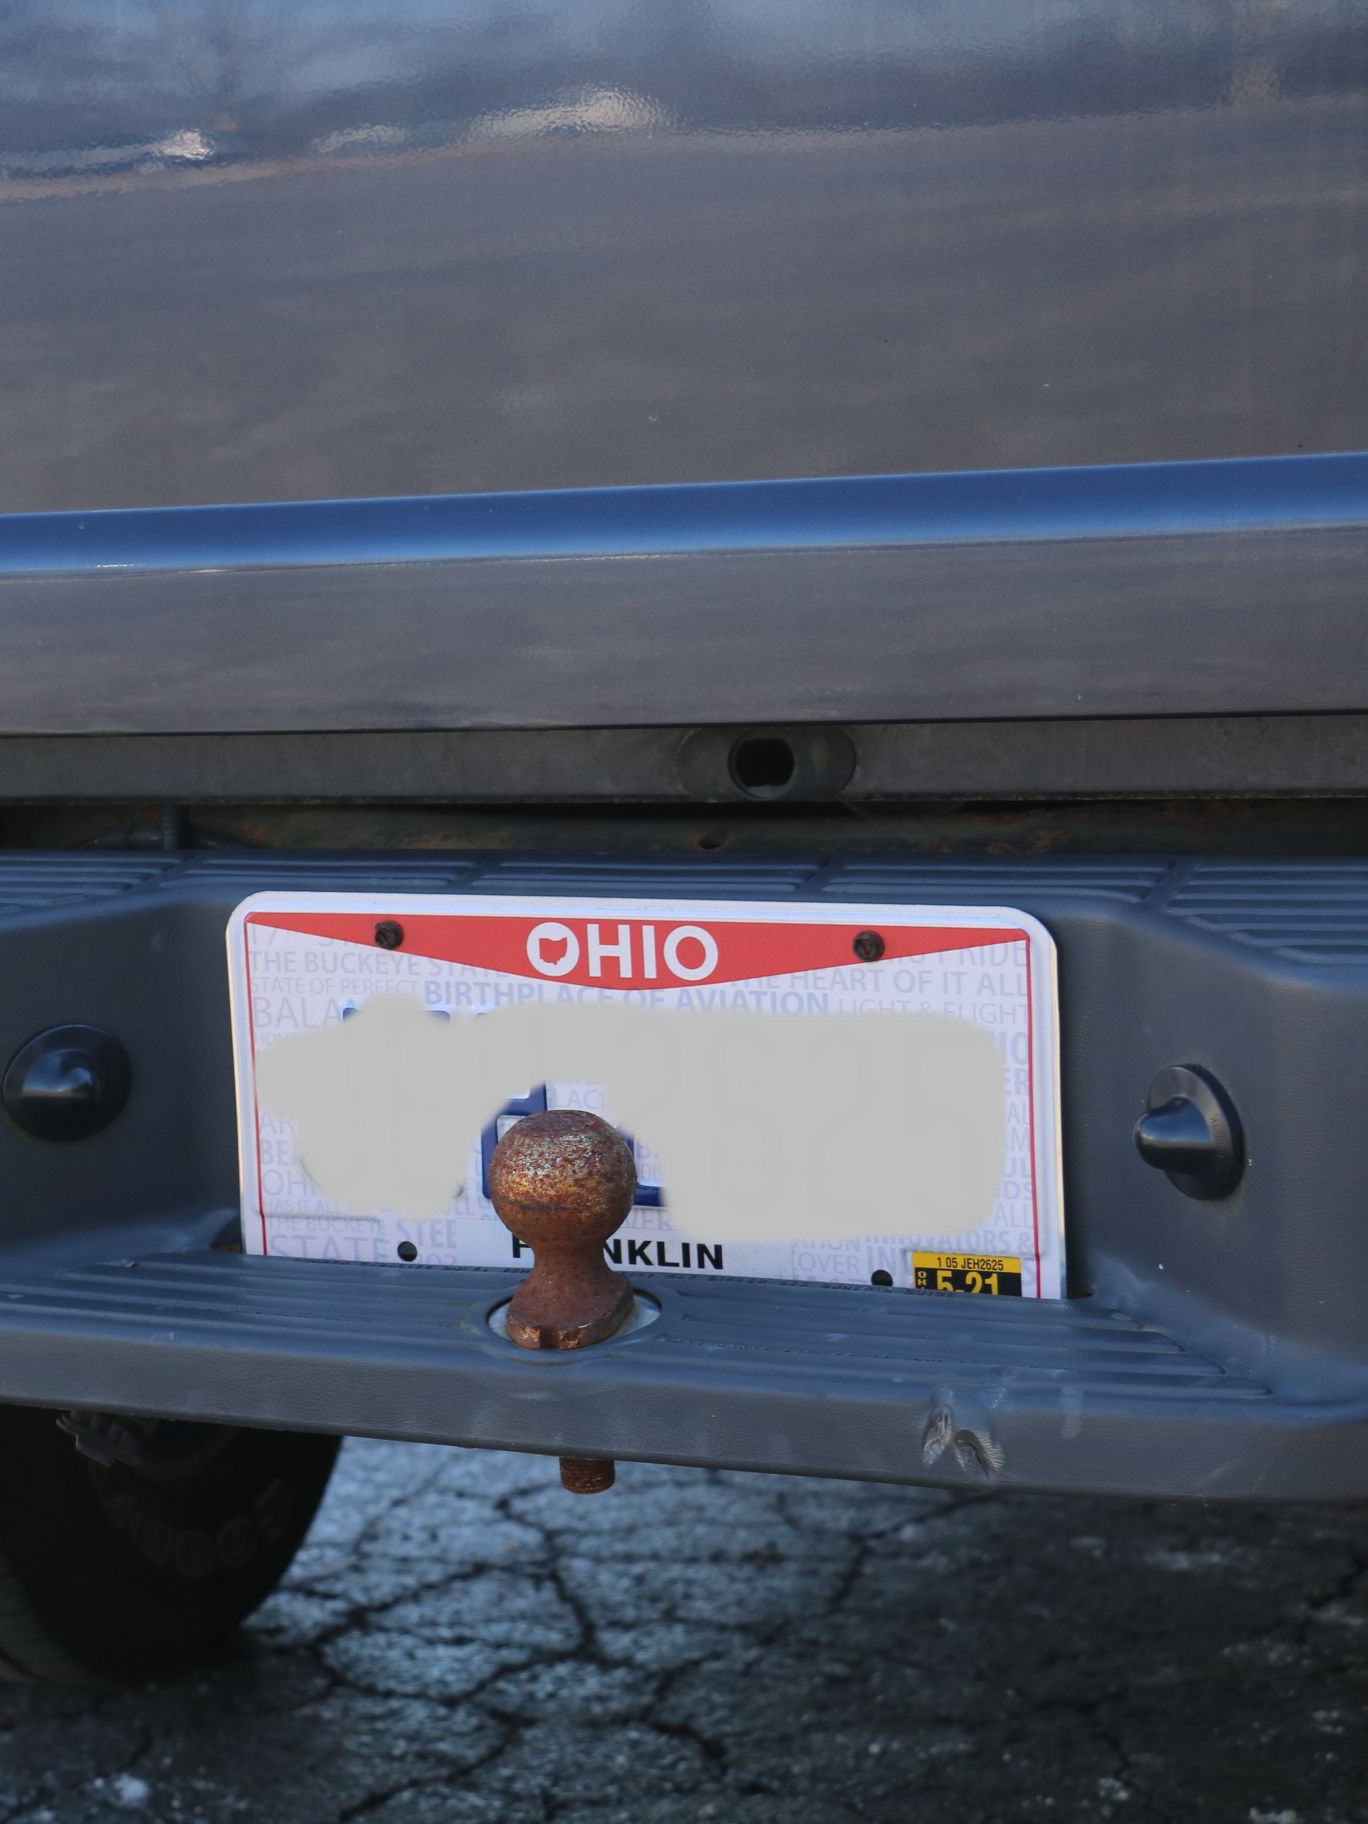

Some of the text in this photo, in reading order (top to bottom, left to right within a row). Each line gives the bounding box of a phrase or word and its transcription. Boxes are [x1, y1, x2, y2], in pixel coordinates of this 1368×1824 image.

[249, 950, 510, 978] THE BUCKEYE STA
[526, 921, 719, 982] OHIO
[250, 976, 305, 994] STATE
[311, 978, 335, 995] OF
[340, 978, 419, 998] PERFECT
[675, 988, 829, 1016] AVIATION
[789, 967, 885, 993] HEART
[893, 969, 933, 994] OF
[942, 970, 968, 995] IT
[976, 972, 1026, 997] ALL
[253, 996, 344, 1029] BALA
[512, 1234, 724, 1270] FNKLIN
[936, 1256, 1004, 1271] 1 05 JEH2625
[936, 1269, 999, 1296] 5-21
